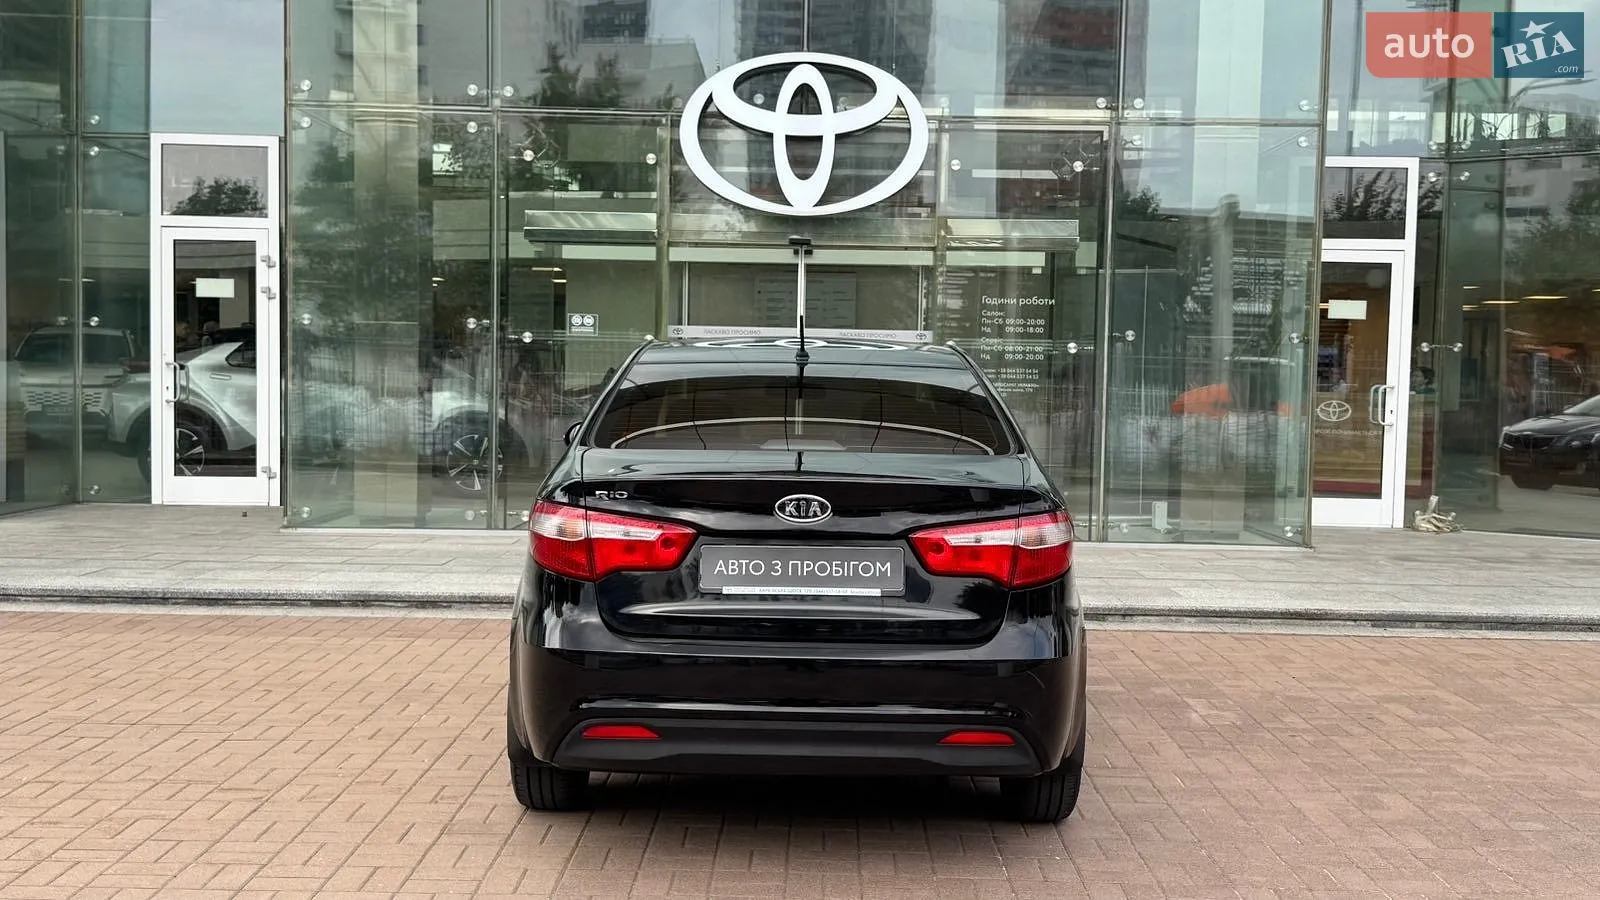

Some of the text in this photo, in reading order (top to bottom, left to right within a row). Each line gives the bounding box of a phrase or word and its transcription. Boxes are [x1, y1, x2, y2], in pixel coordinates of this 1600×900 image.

[981, 295, 1056, 307] Години роботи
[981, 309, 1006, 317] Салон:
[981, 317, 1046, 326] Пн-Сб 09:00-20:00
[1004, 326, 1045, 334] 09:00-18:00
[1004, 353, 1045, 361] 09:00-20:00
[784, 501, 822, 517] KIA
[714, 559, 891, 577] АВТО З ПРОБІГОМ
